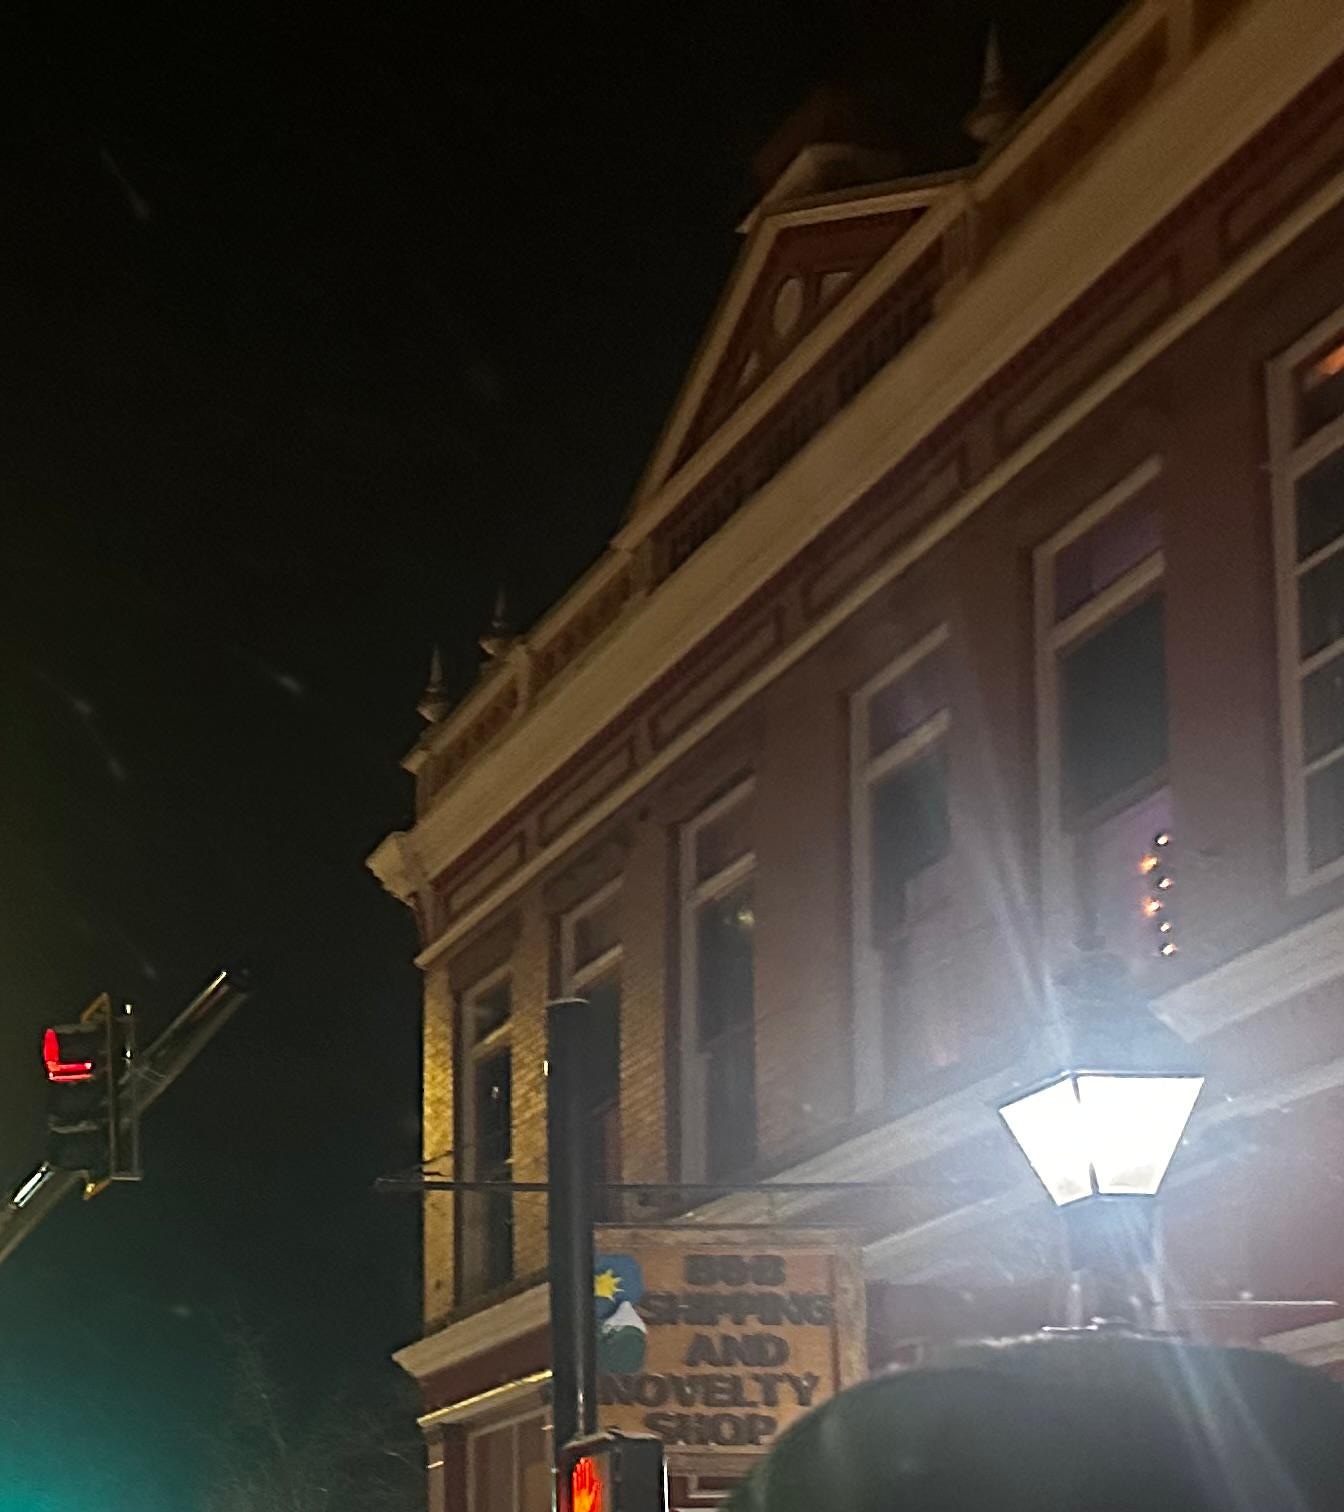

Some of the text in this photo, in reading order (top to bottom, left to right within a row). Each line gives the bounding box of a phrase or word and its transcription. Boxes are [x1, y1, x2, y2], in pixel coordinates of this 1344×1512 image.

[634, 1291, 832, 1325] SHIPPING
[683, 1332, 789, 1367] AND
[597, 1372, 820, 1407] NOVELTY
[644, 1412, 777, 1445] SHOP
